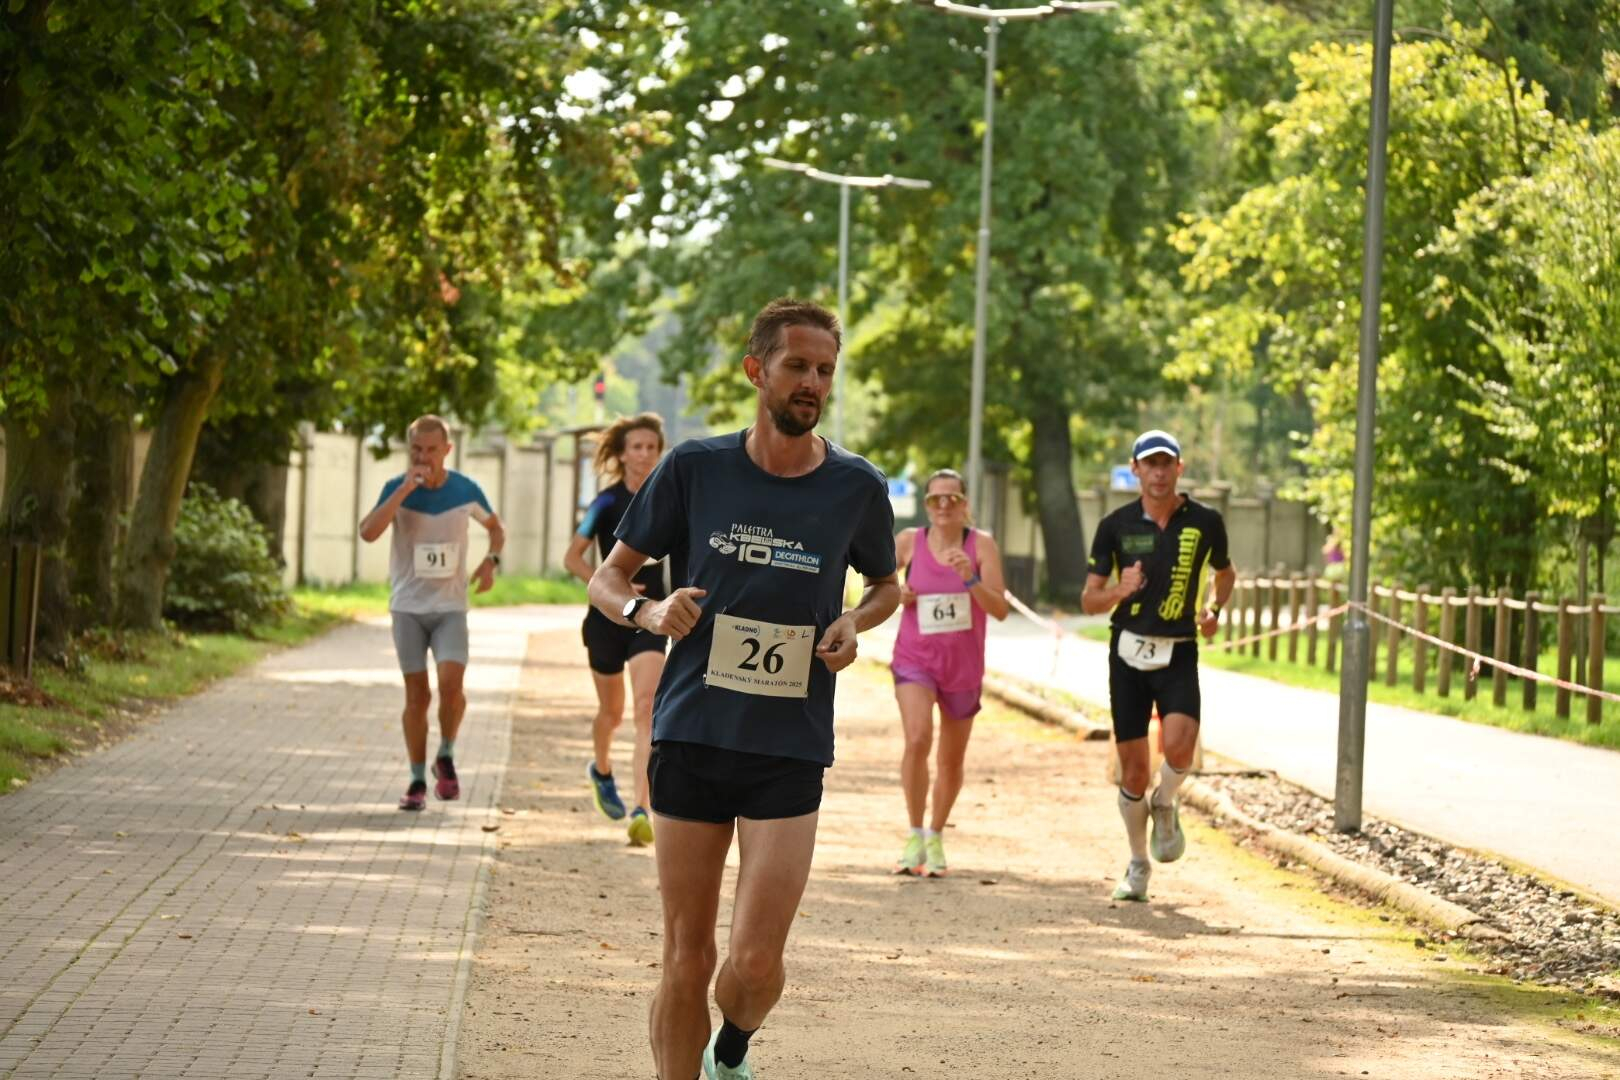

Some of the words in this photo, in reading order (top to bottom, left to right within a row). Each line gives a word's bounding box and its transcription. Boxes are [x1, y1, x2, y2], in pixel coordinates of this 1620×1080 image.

[731, 523, 773, 537] PALESTRA
[427, 551, 445, 567] 91
[738, 543, 772, 565] 10
[775, 551, 819, 566] DECATHLON
[1158, 527, 1202, 620] Svijany
[932, 602, 956, 621] 64
[737, 638, 788, 674] 26
[1135, 639, 1157, 660] 73
